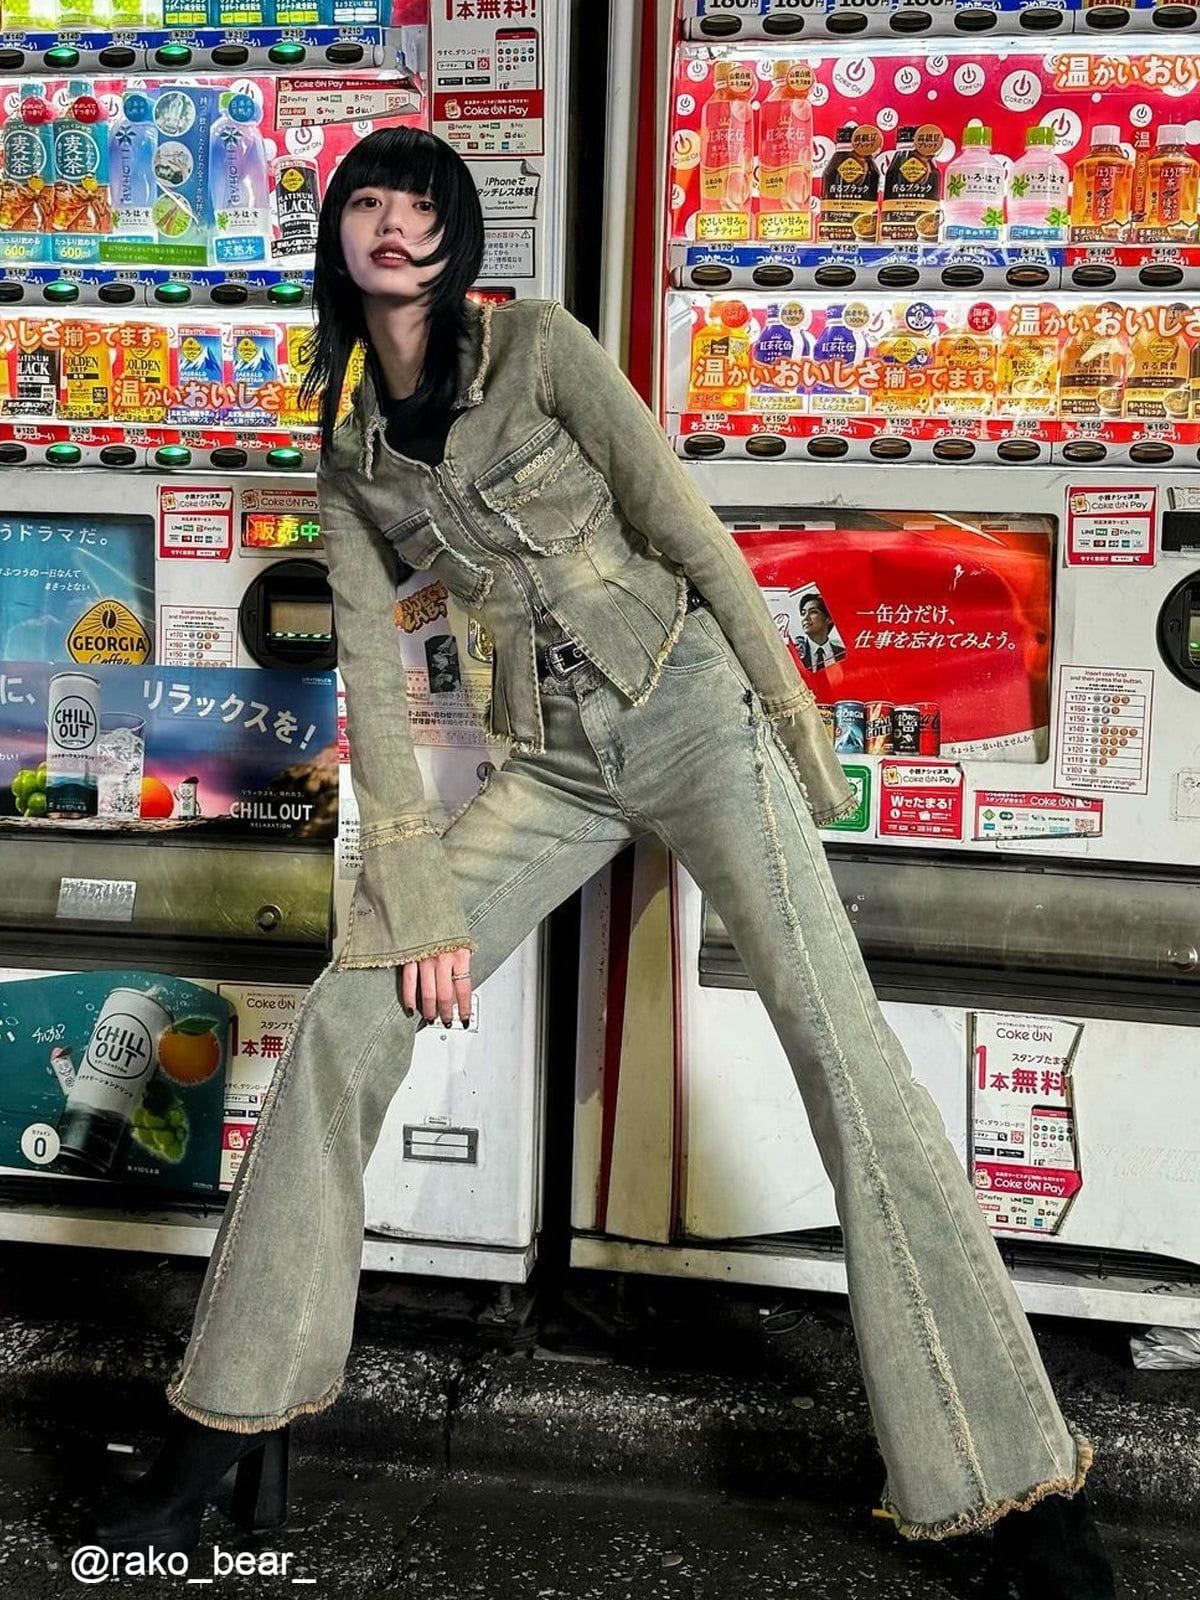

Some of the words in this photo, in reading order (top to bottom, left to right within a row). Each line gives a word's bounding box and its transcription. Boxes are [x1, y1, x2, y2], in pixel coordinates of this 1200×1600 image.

[463, 106, 490, 116] Coke
[491, 105, 507, 115] ON
[508, 106, 528, 117] Pay
[11, 134, 32, 175] 麦茶
[64, 134, 85, 175] 麦茶
[485, 177, 526, 187] iPhoneで
[694, 357, 995, 391] 温かいおいしさ揃ってます。
[212, 500, 227, 509] Pay
[261, 498, 285, 507] Coke
[286, 497, 301, 507] ON
[302, 498, 319, 509] Pay
[1091, 501, 1114, 510] Coke
[1115, 500, 1129, 509] ON
[1130, 501, 1148, 510] Pay
[0, 525, 108, 546] うドラマだ。
[253, 516, 321, 543] 販売中
[857, 603, 956, 626] 一缶分だけ、
[73, 636, 147, 652] GEORGIA
[854, 631, 1017, 651] 仕事を忘れてみよう。
[0, 675, 36, 705] に、
[55, 709, 94, 726] CHILL
[143, 680, 317, 751] リラックスを!
[59, 724, 90, 739] OUT
[939, 775, 956, 785] Pay
[230, 802, 278, 820] CHILL
[279, 804, 313, 821] OUT
[890, 794, 953, 811] Wでたまる!
[1031, 796, 1058, 806] Coke
[1059, 797, 1076, 808] ON
[246, 998, 276, 1010] Coke
[277, 997, 295, 1010] ON
[96, 1025, 147, 1059] CHILL
[996, 1027, 1030, 1041] Coke
[1031, 1026, 1053, 1042] ON
[95, 1043, 138, 1068] OUT
[974, 1044, 1068, 1098] 1本無料
[33, 1137, 46, 1158] 0
[994, 1177, 1022, 1190] Coke
[1023, 1177, 1041, 1192] ON
[1043, 1183, 1065, 1196] Pay
